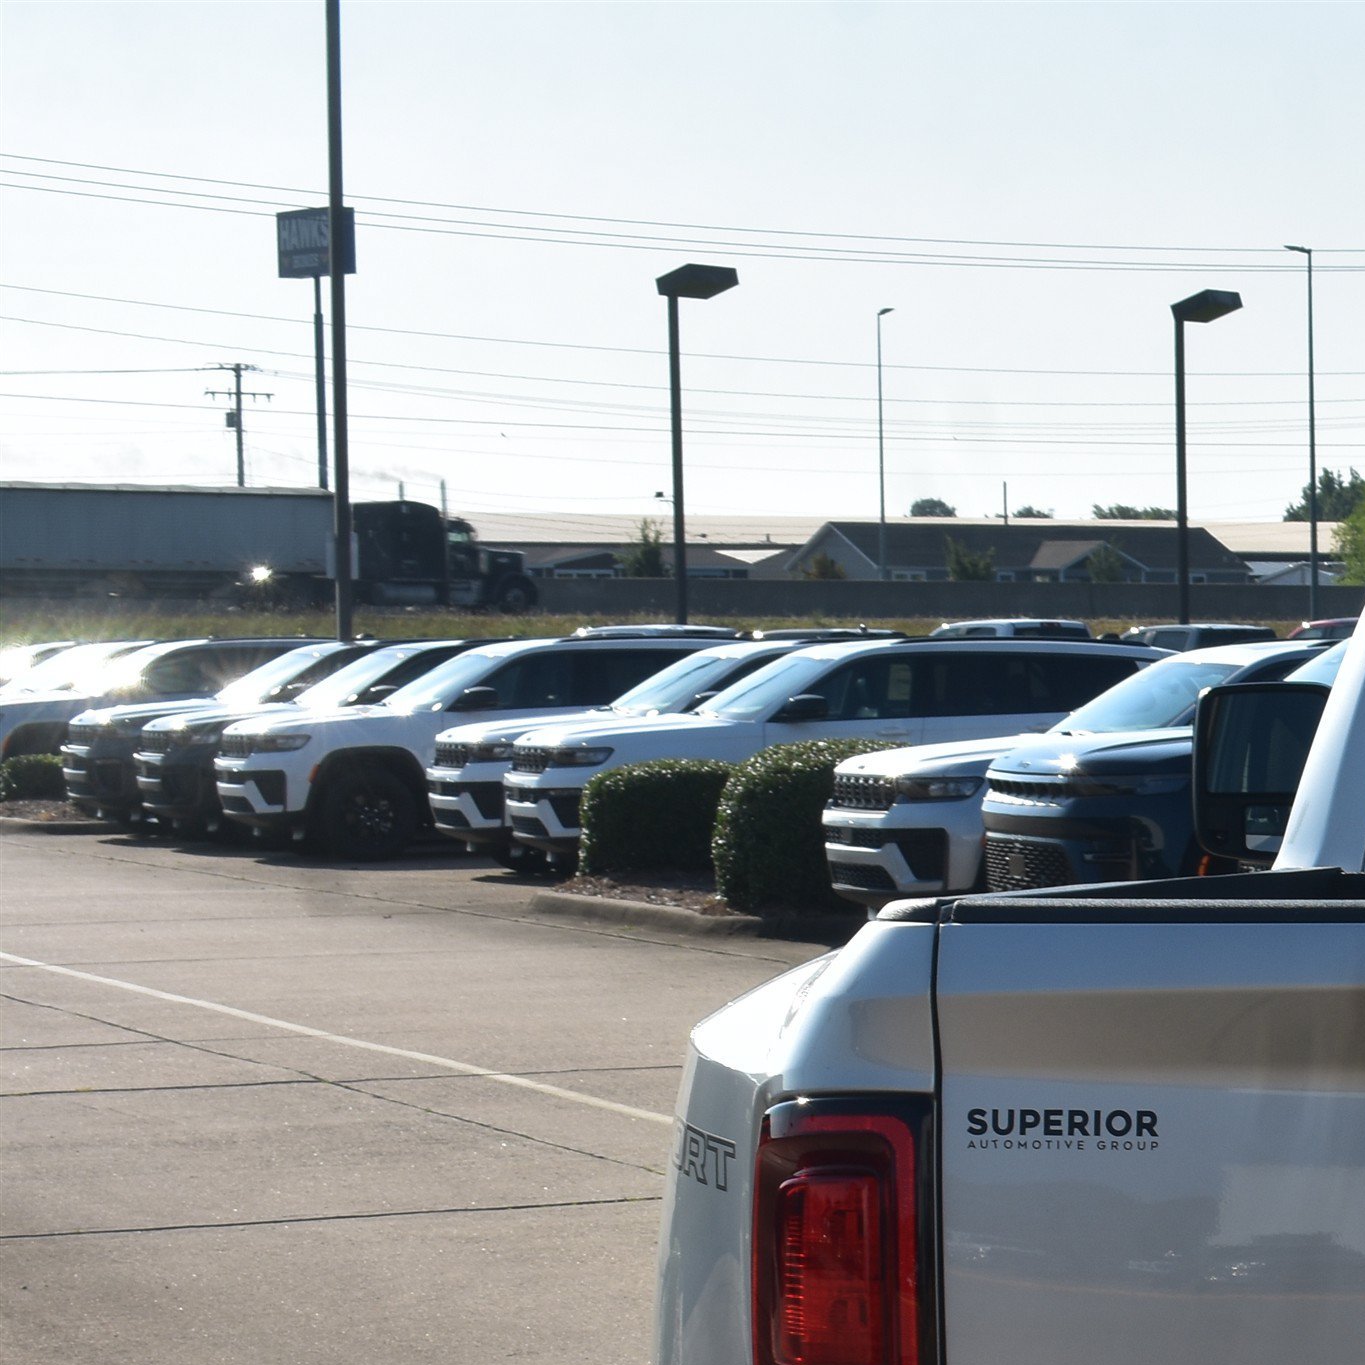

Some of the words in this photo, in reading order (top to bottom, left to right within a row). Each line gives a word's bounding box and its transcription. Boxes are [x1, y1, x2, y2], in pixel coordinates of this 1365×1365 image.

[967, 1108, 1159, 1137] SUPERIOR
[967, 1139, 1085, 1151] AUTOMOTIVE
[1096, 1140, 1160, 1151] GROUP
